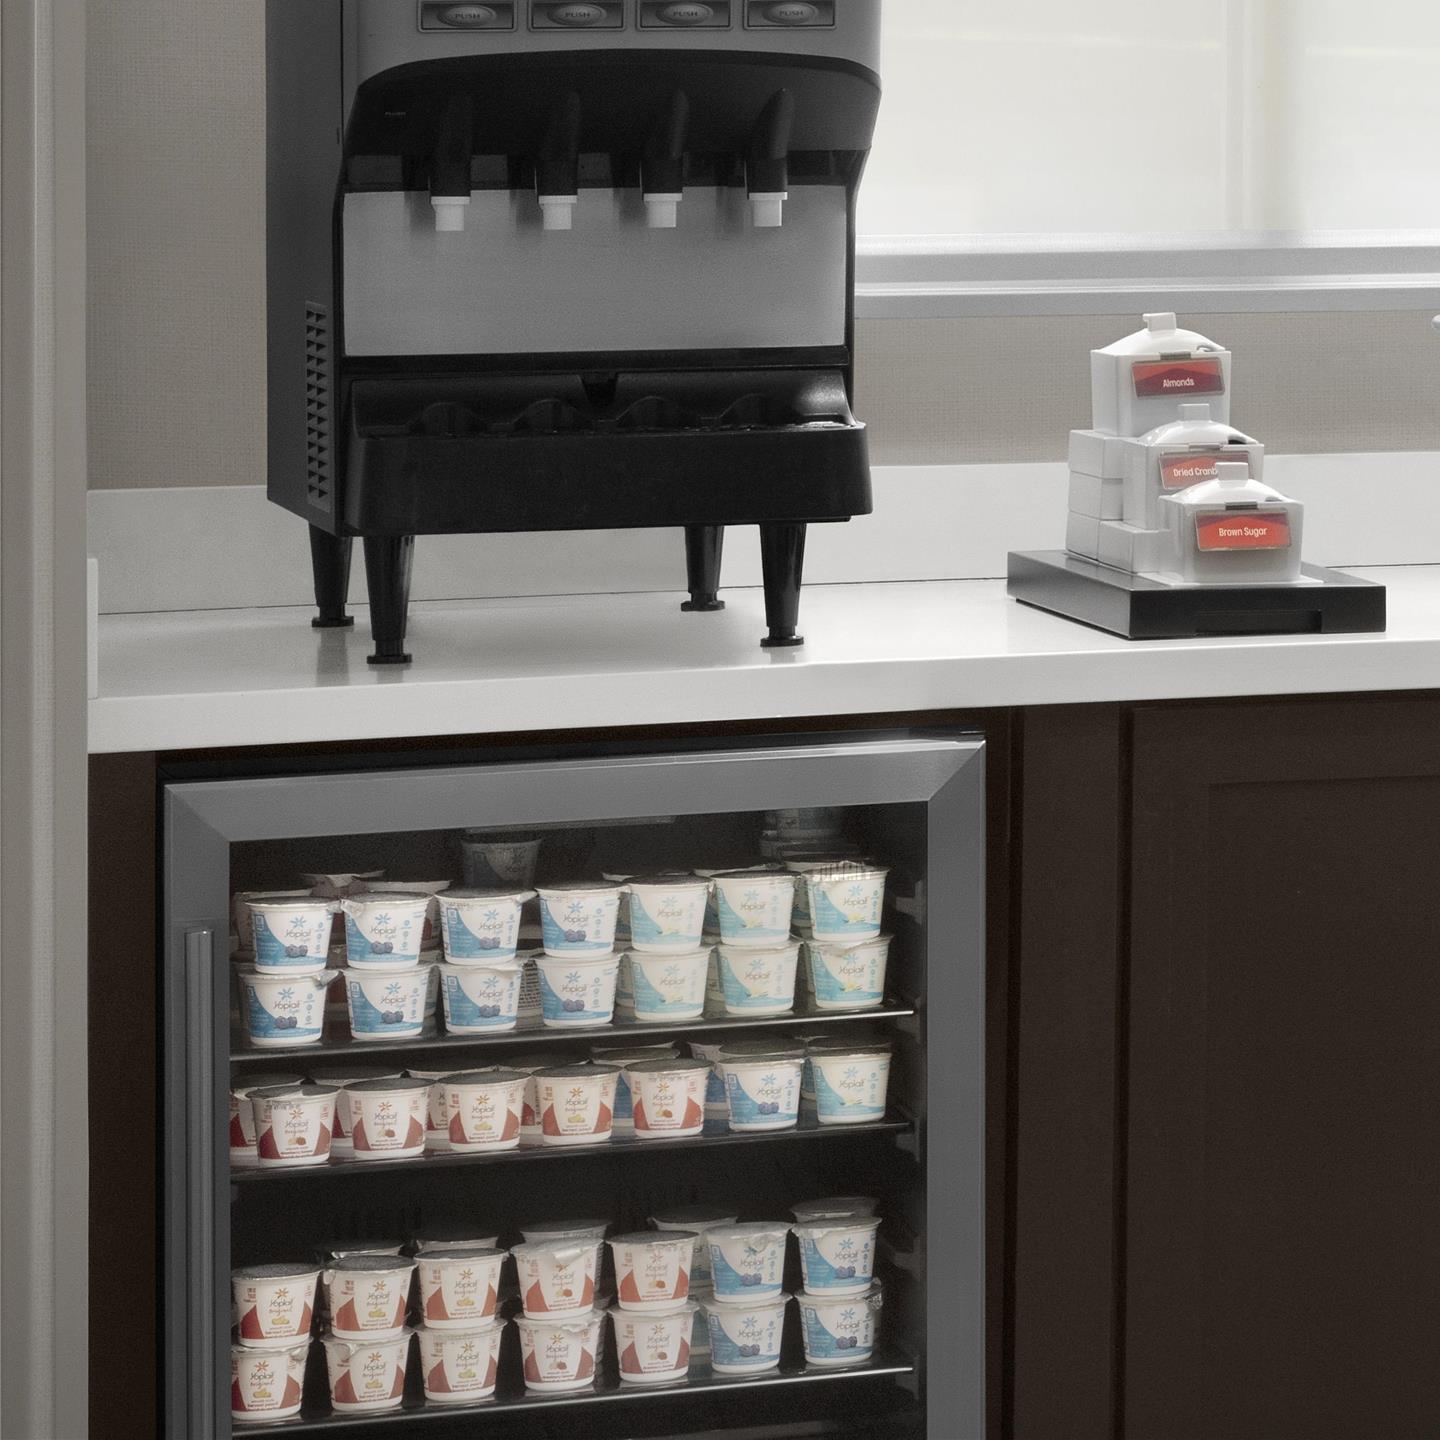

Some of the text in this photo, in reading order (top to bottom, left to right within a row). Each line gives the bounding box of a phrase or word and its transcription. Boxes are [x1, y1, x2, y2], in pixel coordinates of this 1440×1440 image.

[1163, 377, 1195, 388] Almonds
[1173, 468, 1194, 477] Dried
[1219, 527, 1267, 538] Brown Sugar
